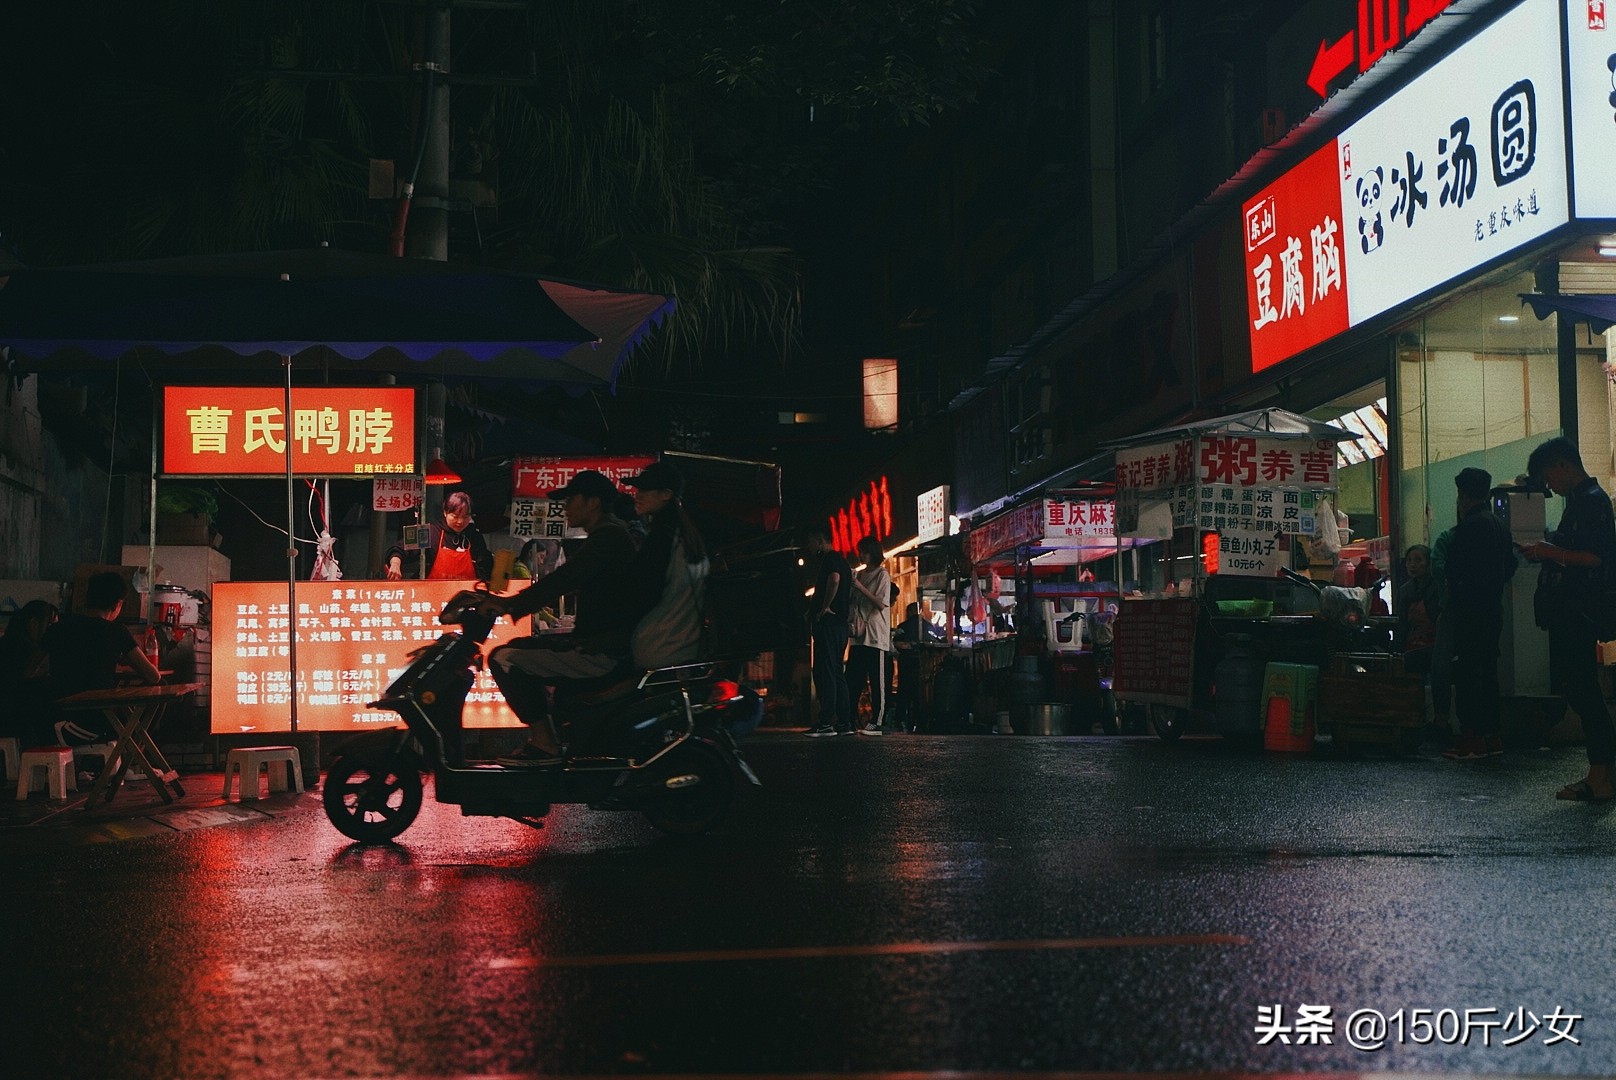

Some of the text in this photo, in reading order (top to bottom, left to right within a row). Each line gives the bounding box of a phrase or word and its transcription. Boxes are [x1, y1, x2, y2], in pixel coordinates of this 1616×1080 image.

[1390, 79, 1537, 228] 冰汤圆
[1474, 188, 1541, 242] 老重庆味道
[1251, 208, 1272, 241] 乐山
[1253, 215, 1341, 331] 豆腐脑
[186, 406, 393, 454] 曹氏鸭脖
[354, 463, 414, 473] 团结红光分店
[1115, 440, 1194, 489] 陈记营养粥
[376, 478, 423, 492] 开业期间
[376, 493, 423, 509] 全场8折
[1201, 487, 1253, 501] 醪糟蛋
[1257, 490, 1299, 504] 凉面
[515, 501, 566, 518] 凉皮
[1257, 506, 1299, 519] 凉皮
[514, 519, 563, 536] 凉面
[1220, 536, 1276, 556] 章鱼小丸子
[1228, 558, 1265, 571] 10元6个
